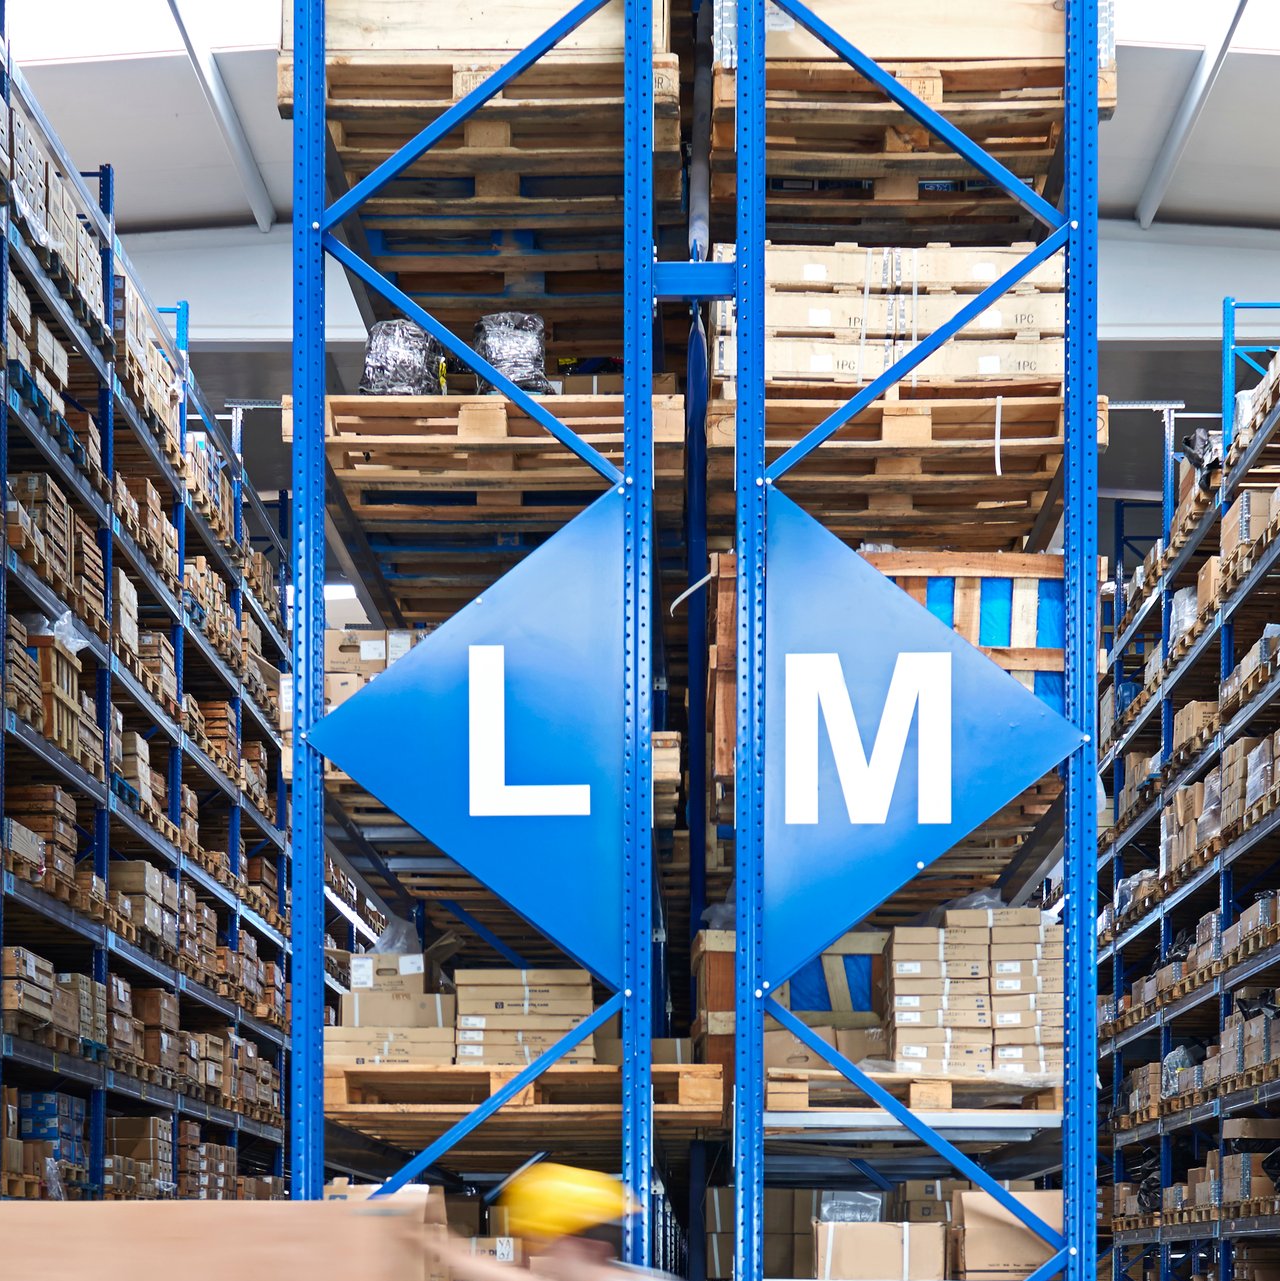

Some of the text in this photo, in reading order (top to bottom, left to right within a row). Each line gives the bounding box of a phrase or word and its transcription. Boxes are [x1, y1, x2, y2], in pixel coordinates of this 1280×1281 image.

[1014, 313, 1035, 325] 1PC
[836, 359, 856, 371] 1PC
[1017, 360, 1037, 371] 1PC
[468, 645, 591, 817] L
[784, 651, 953, 826] M
